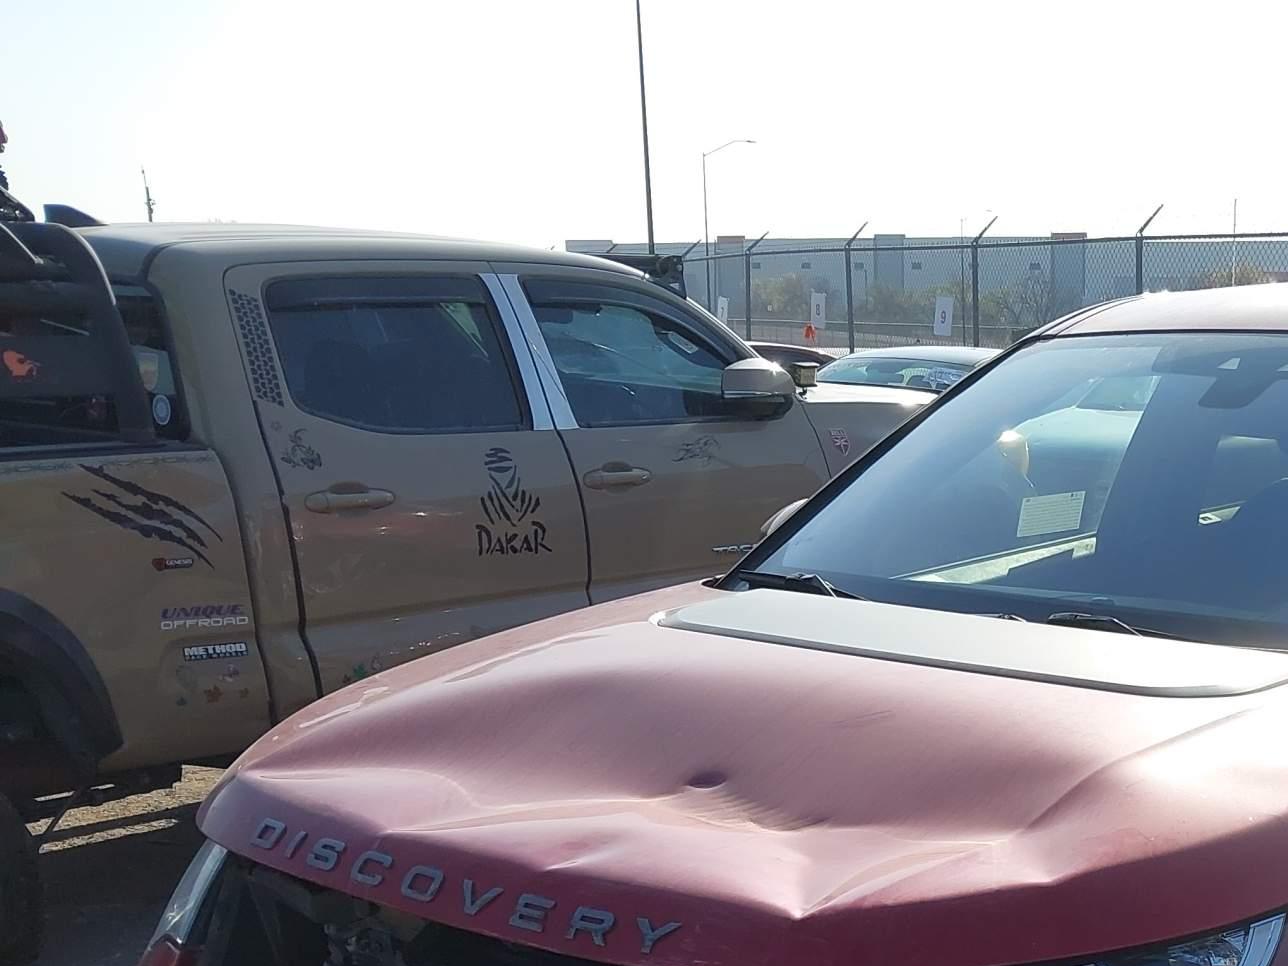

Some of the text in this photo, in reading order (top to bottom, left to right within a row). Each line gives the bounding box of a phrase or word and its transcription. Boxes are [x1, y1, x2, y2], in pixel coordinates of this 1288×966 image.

[815, 303, 821, 317] 8
[940, 310, 947, 325] 9
[475, 520, 553, 557] DAKAR
[160, 604, 245, 619] UNIQUE
[160, 617, 249, 630] OFFROAD
[184, 642, 247, 655] METHOD
[251, 817, 682, 954] DISCOVERY
